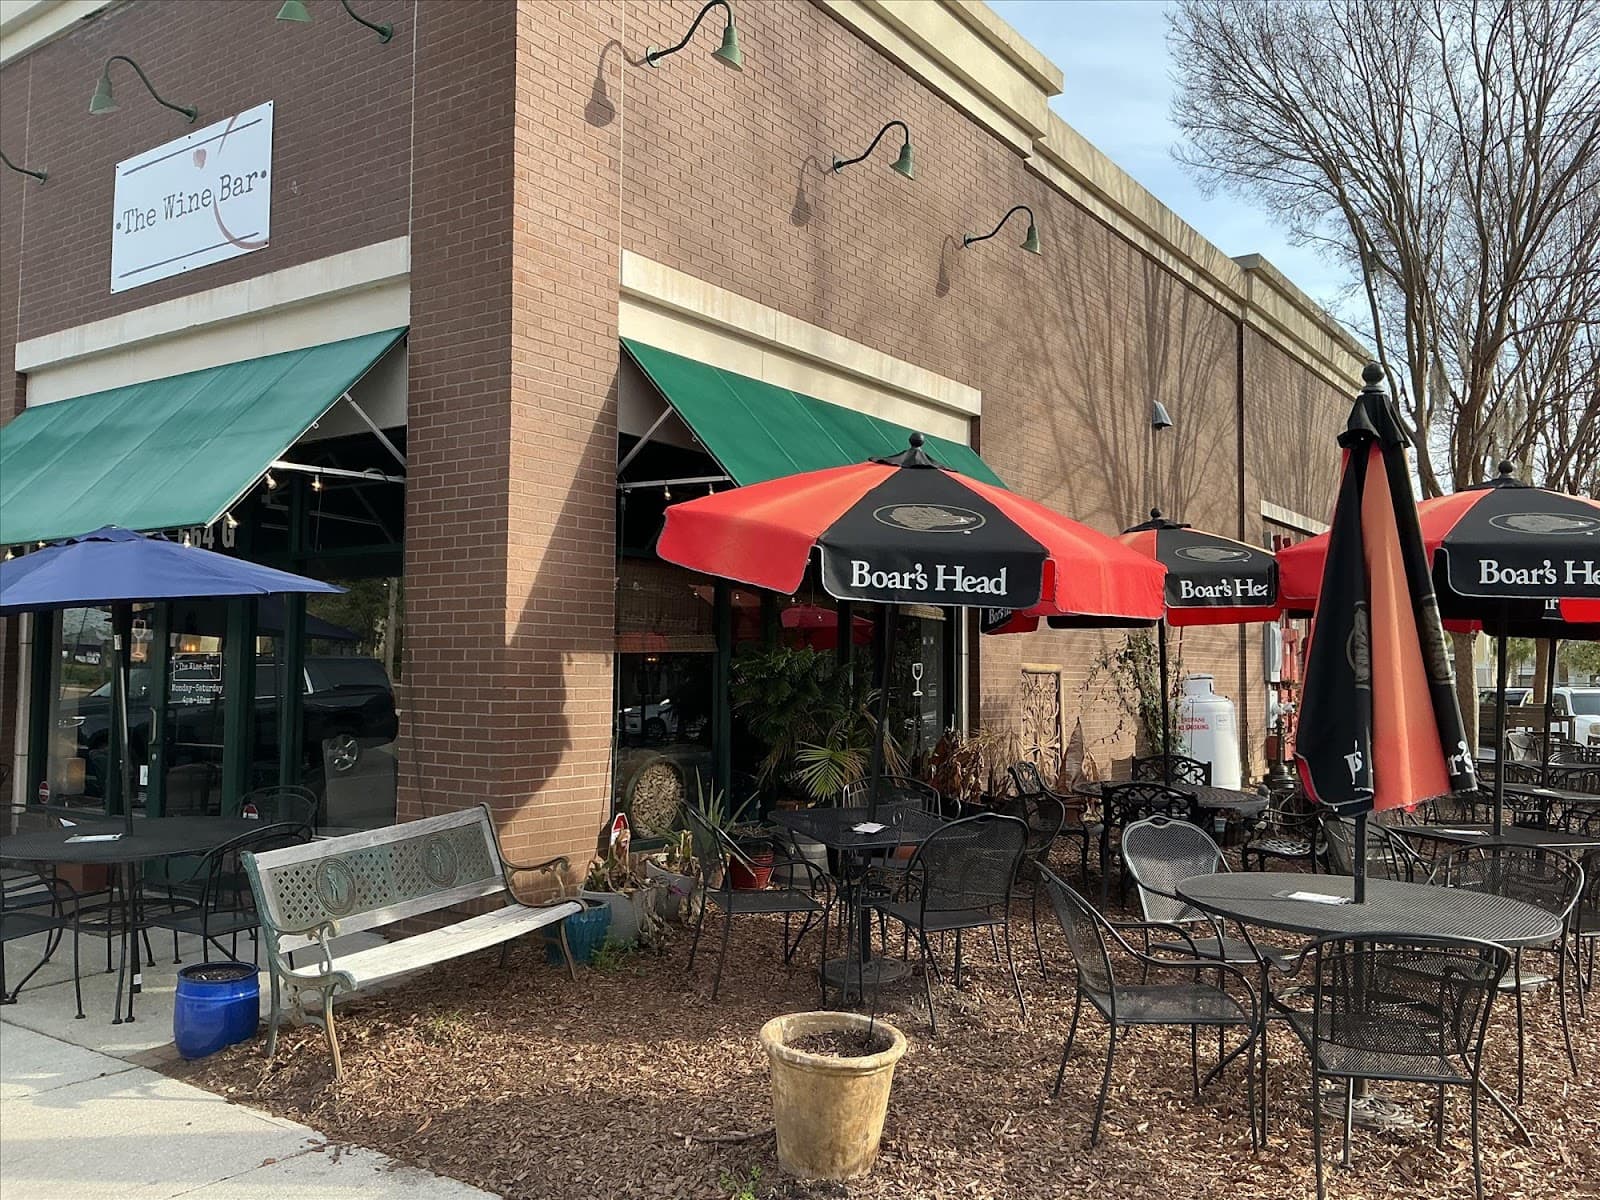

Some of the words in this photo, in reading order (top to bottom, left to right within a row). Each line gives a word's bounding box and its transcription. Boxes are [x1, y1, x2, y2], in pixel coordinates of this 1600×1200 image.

[123, 208, 156, 234] The
[163, 187, 212, 220] Wine
[219, 171, 258, 202] Bar
[850, 560, 928, 590] Boar's
[935, 564, 1008, 596] Head
[1479, 559, 1558, 585] Boar's
[1563, 560, 1600, 585] He
[1180, 579, 1233, 599] Boar's
[1234, 578, 1268, 597] He
